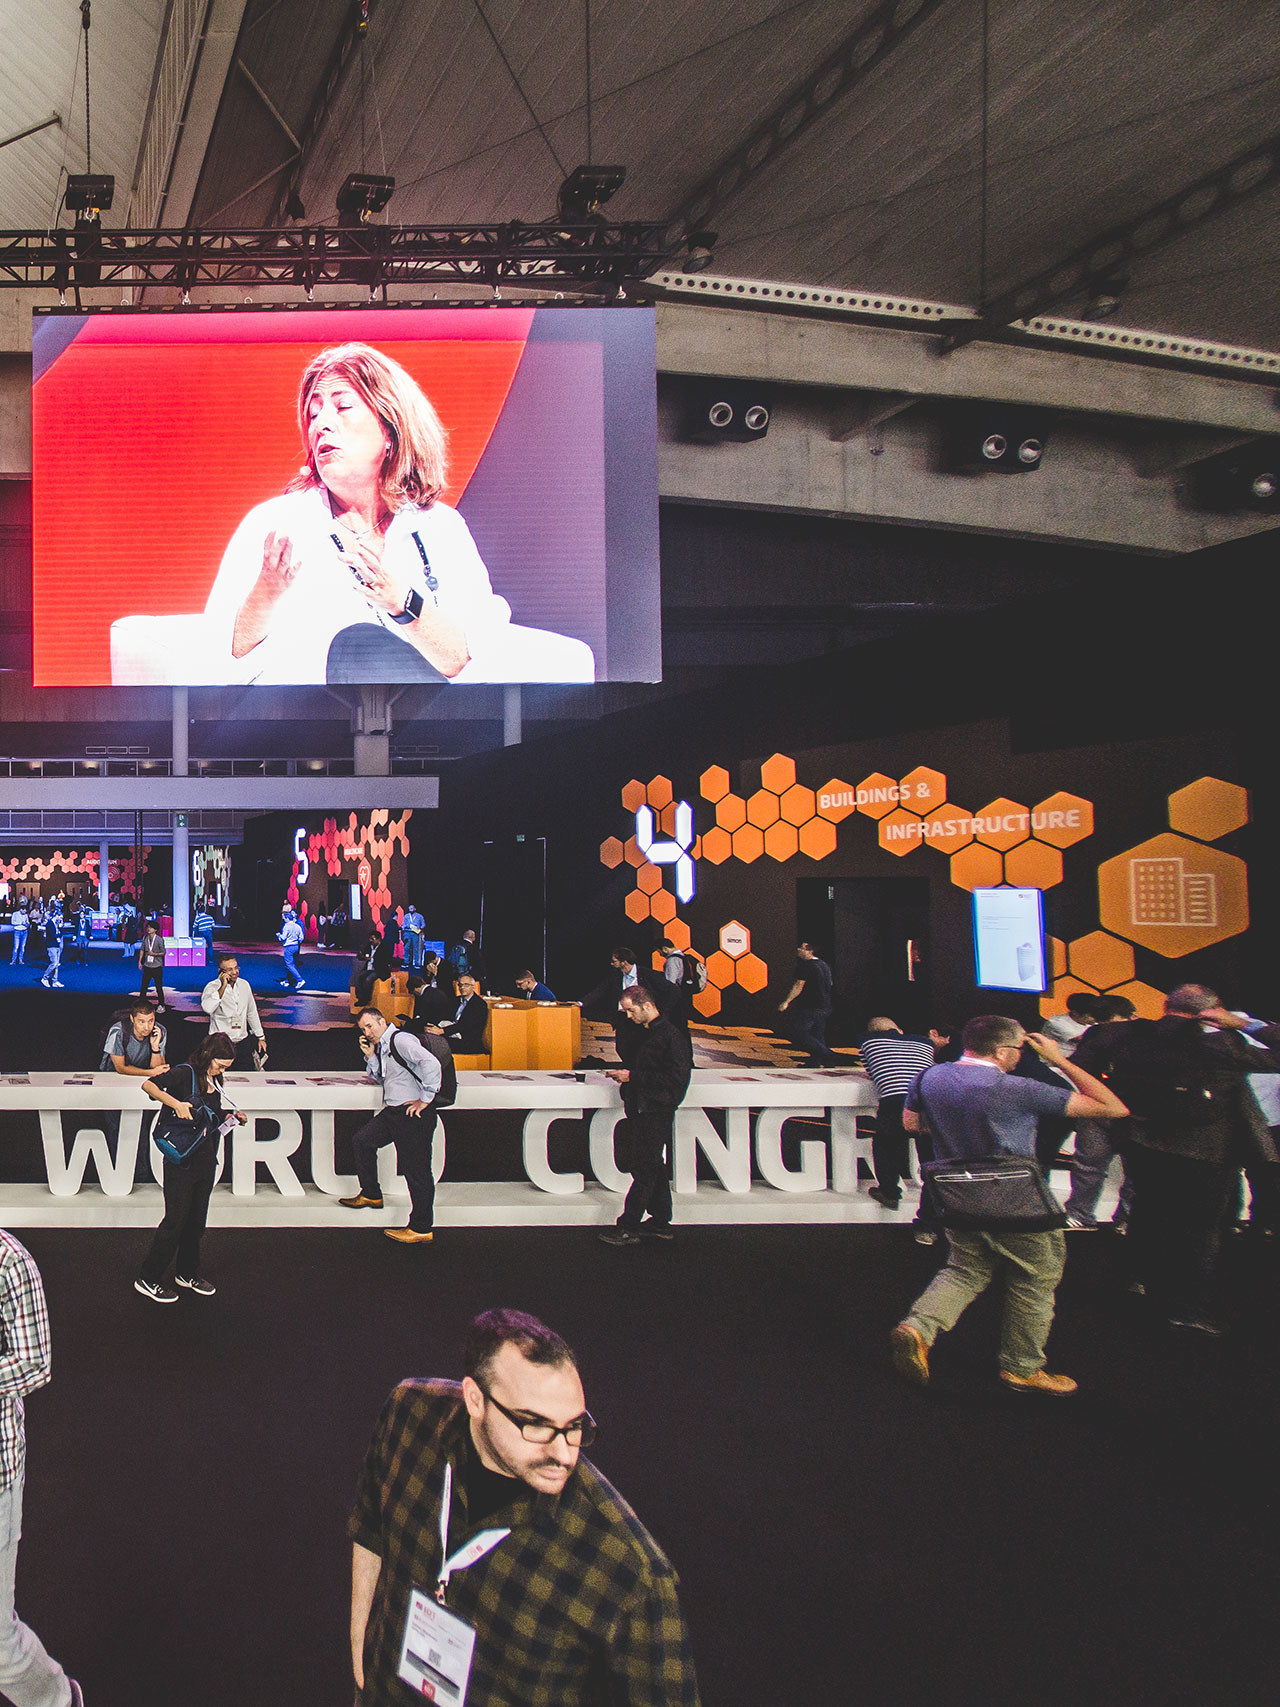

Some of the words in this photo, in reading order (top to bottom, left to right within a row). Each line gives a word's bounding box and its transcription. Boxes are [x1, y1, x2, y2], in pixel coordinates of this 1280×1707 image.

[820, 784, 910, 809] BUILDINGS
[916, 782, 930, 798] &
[886, 809, 1081, 840] INFRASTRUCTURE
[295, 827, 309, 885] 5
[636, 800, 696, 904] 4
[523, 1106, 1123, 1193] CNGR
